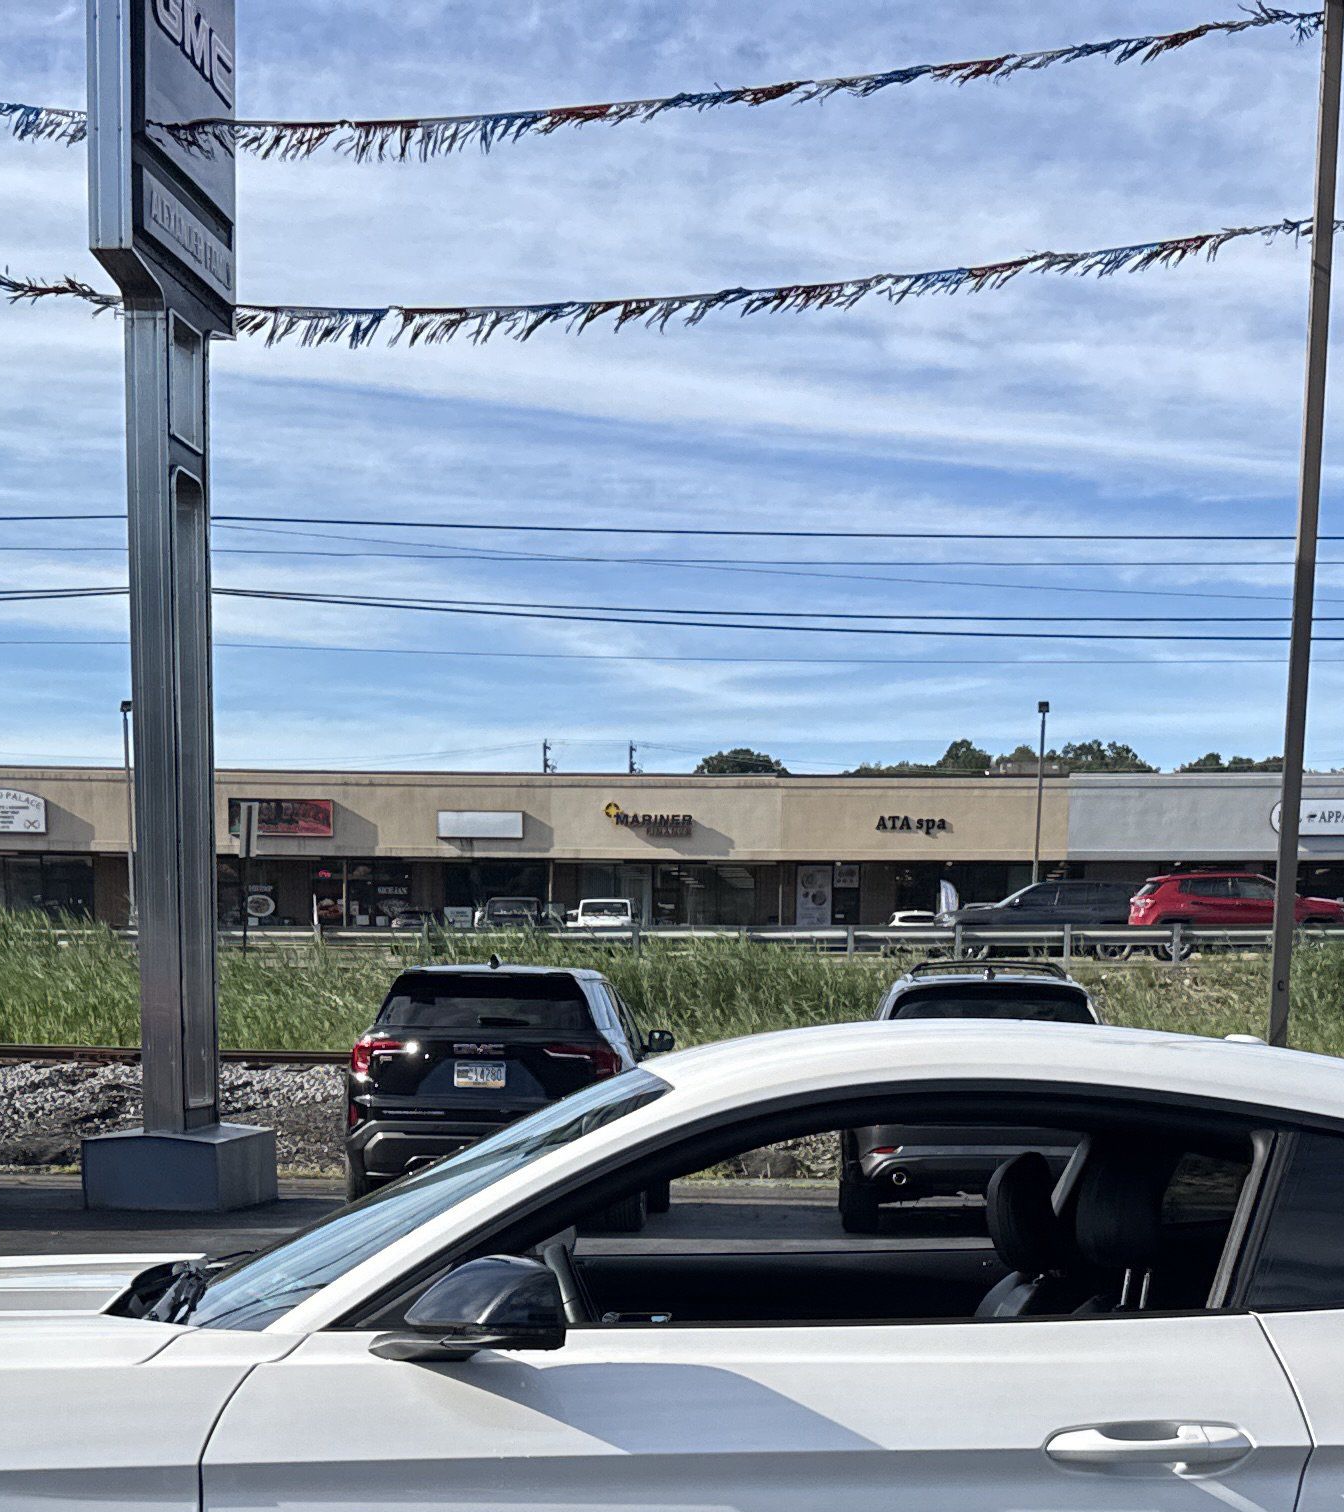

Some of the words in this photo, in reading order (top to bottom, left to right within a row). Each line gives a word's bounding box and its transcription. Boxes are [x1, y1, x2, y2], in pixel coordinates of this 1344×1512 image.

[615, 812, 693, 827] MARINER
[875, 815, 912, 831] ATA
[916, 818, 946, 835] spa
